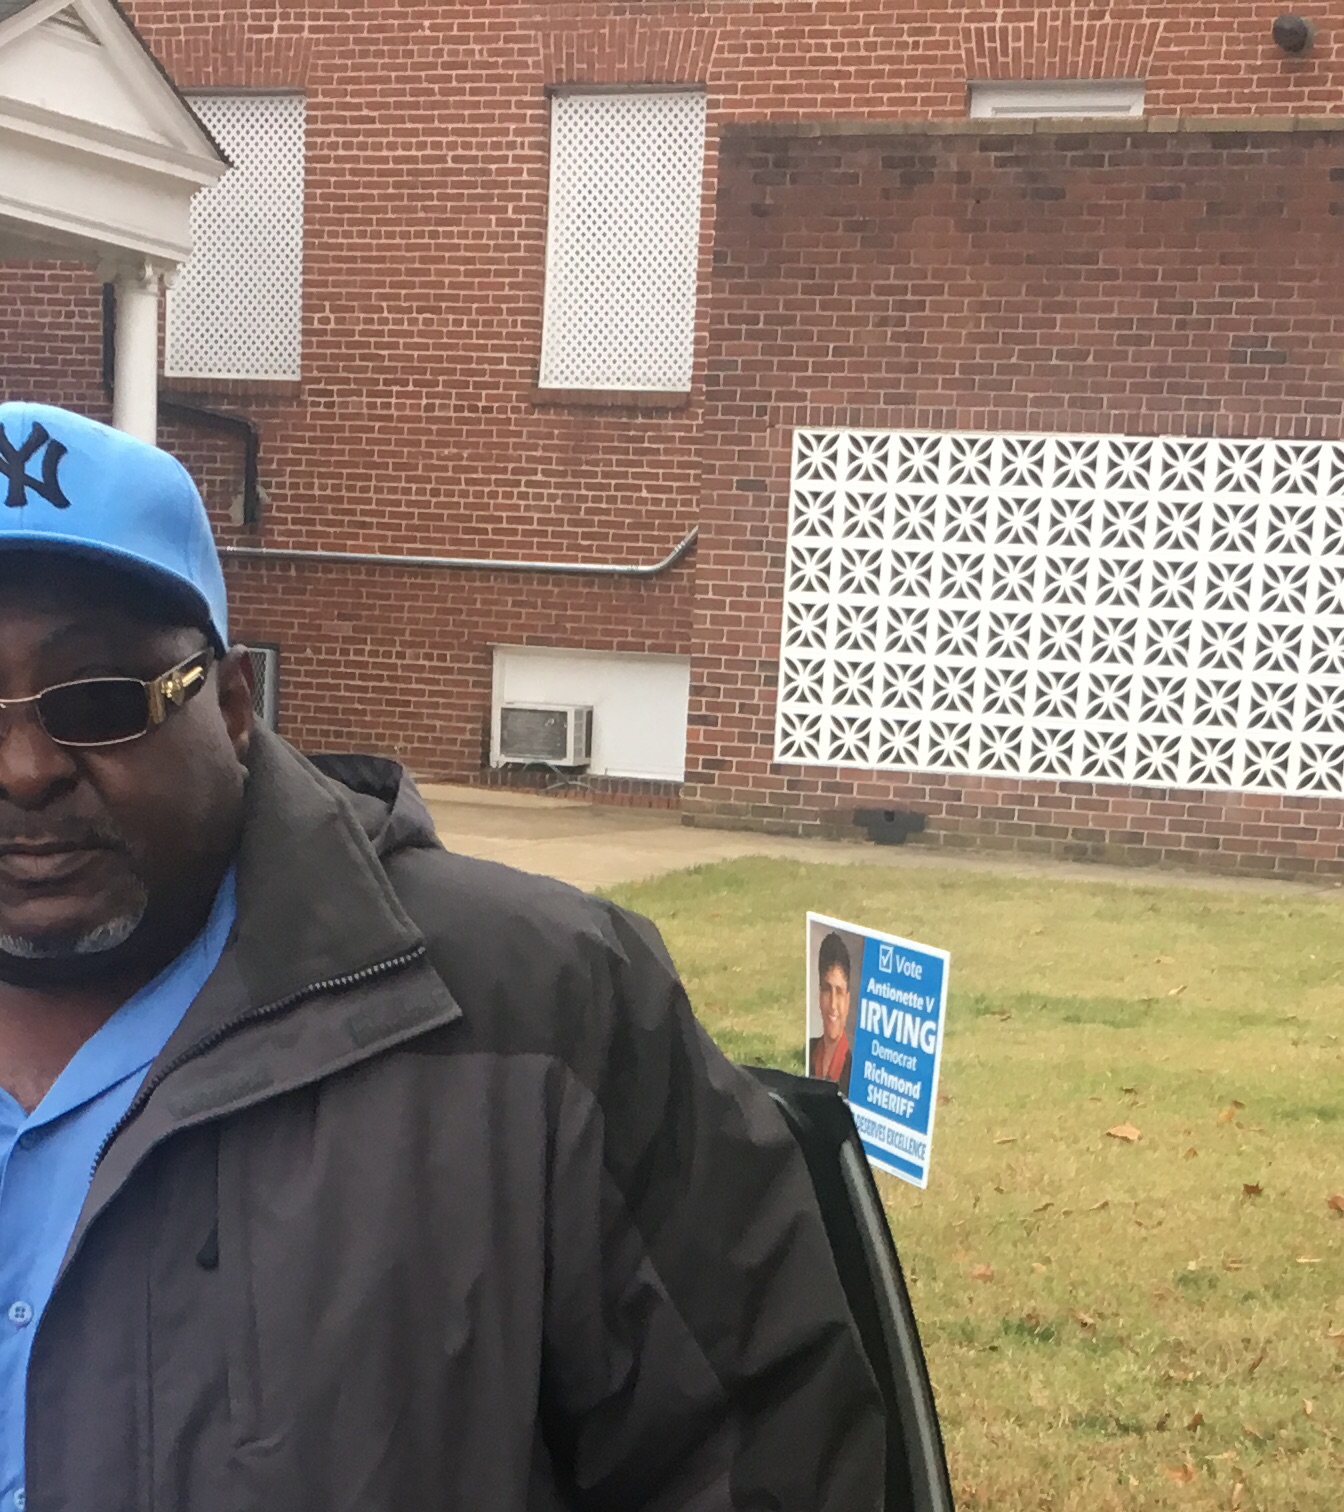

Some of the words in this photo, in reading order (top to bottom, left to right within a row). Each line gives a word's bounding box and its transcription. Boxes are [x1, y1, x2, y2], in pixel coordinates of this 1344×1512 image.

[895, 954, 923, 980] Vote
[866, 977, 924, 1011] Antionette
[925, 996, 935, 1014] V
[859, 998, 937, 1055] IRVING
[871, 1039, 918, 1072] Democrat
[863, 1060, 922, 1101] Richmond
[866, 1083, 915, 1119] SHERIFF
